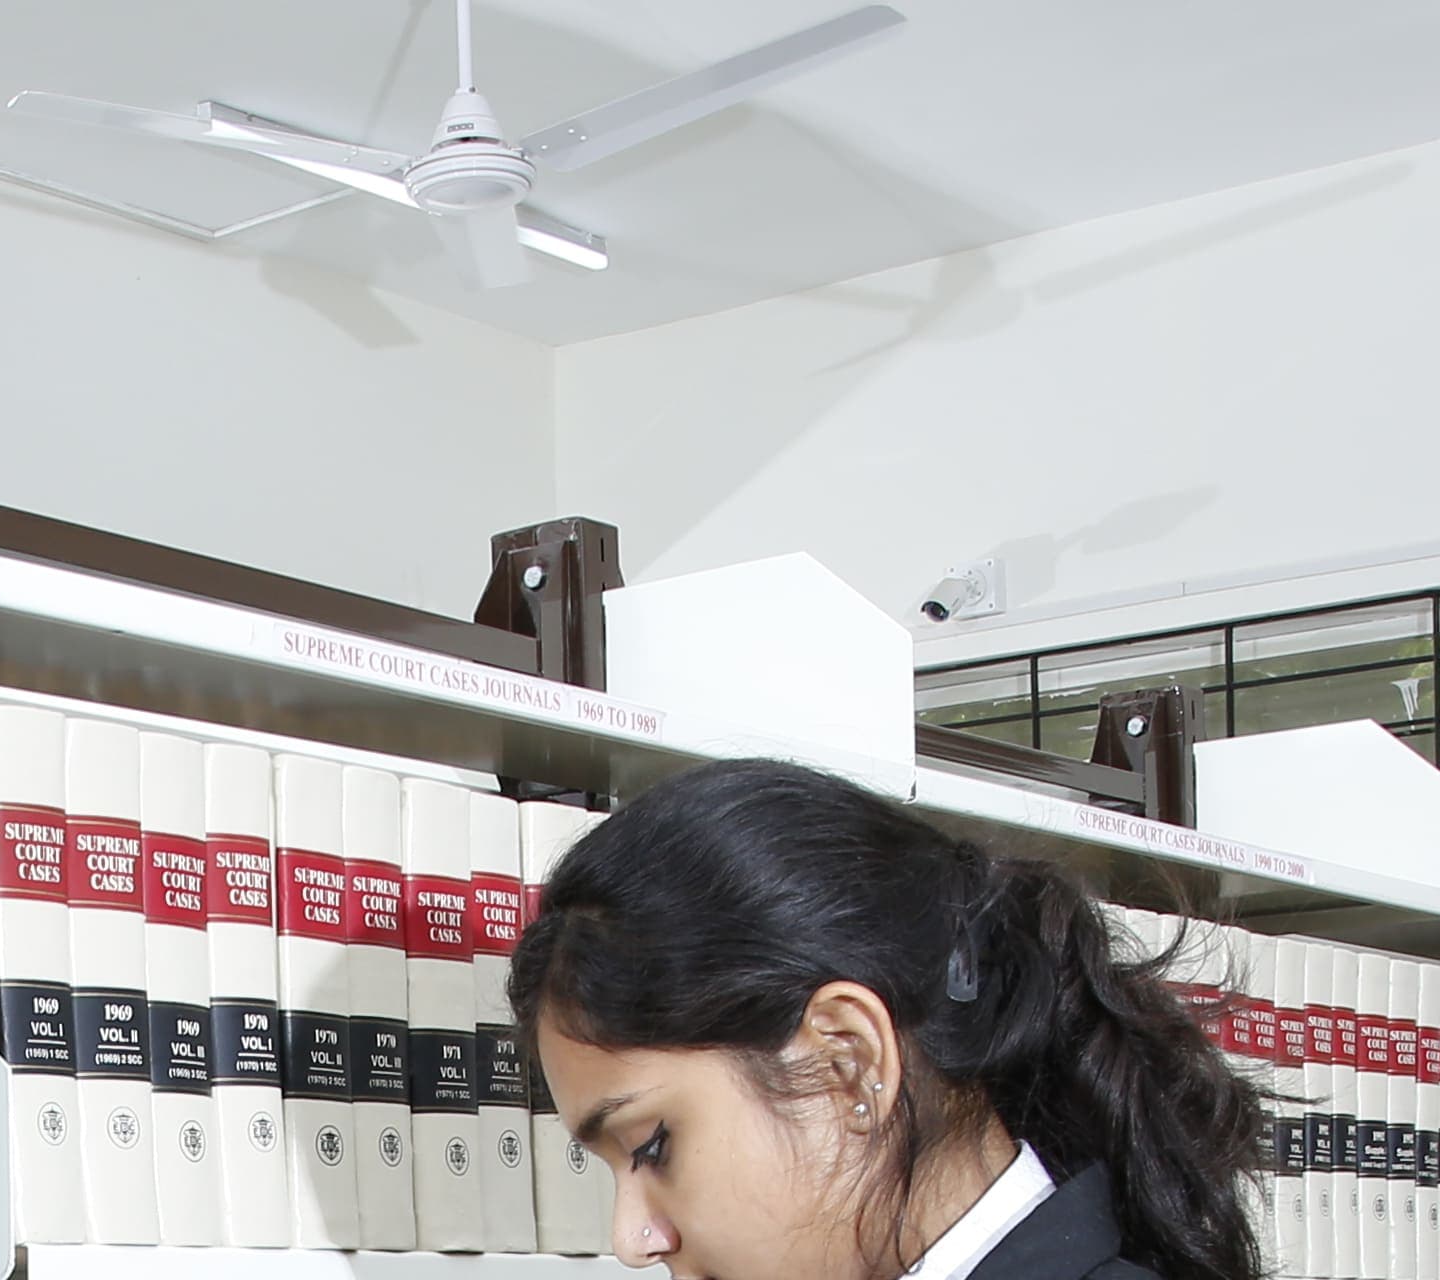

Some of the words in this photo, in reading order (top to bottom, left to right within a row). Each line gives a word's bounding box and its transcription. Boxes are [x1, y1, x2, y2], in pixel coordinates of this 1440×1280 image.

[284, 631, 364, 669] SUPREME
[369, 651, 425, 681] COURT
[430, 664, 479, 694] CASES
[483, 677, 561, 712] JOURNALS
[577, 699, 603, 722] 1969
[608, 706, 627, 729] TO
[631, 712, 656, 735] 1989
[77, 834, 140, 857] SUPREME
[1079, 811, 1127, 836] SUPREME
[1129, 822, 1164, 843] COURT
[1165, 831, 1195, 852] CASES
[1197, 837, 1245, 864] JOURNALS
[1273, 858, 1286, 874] TO
[87, 855, 135, 874] COURT
[90, 874, 134, 893] CASES
[163, 872, 201, 892] COURT
[166, 891, 201, 910] CASES
[303, 887, 341, 907] COURT
[362, 895, 397, 913] COURT
[418, 892, 466, 911] SUPREME
[305, 905, 340, 925] CASES
[365, 913, 396, 930] CASES
[427, 910, 461, 927] COURT
[430, 928, 461, 943] CASES
[33, 998, 59, 1015] 1969
[104, 1003, 133, 1021] 1969
[31, 1022, 57, 1037] VOL.
[58, 1023, 63, 1036] I
[177, 1020, 200, 1036] 1969
[244, 1014, 268, 1031] 1970
[100, 1028, 129, 1042] VOL.
[131, 1029, 138, 1043] II
[315, 1029, 337, 1044] 1970
[376, 1033, 396, 1048] 1970
[127, 1054, 142, 1065] SCC
[311, 1051, 335, 1065] VOL.
[336, 1053, 342, 1066] II
[443, 1045, 461, 1061] 1971
[440, 1067, 461, 1079] VOL.
[463, 1069, 466, 1079] I
